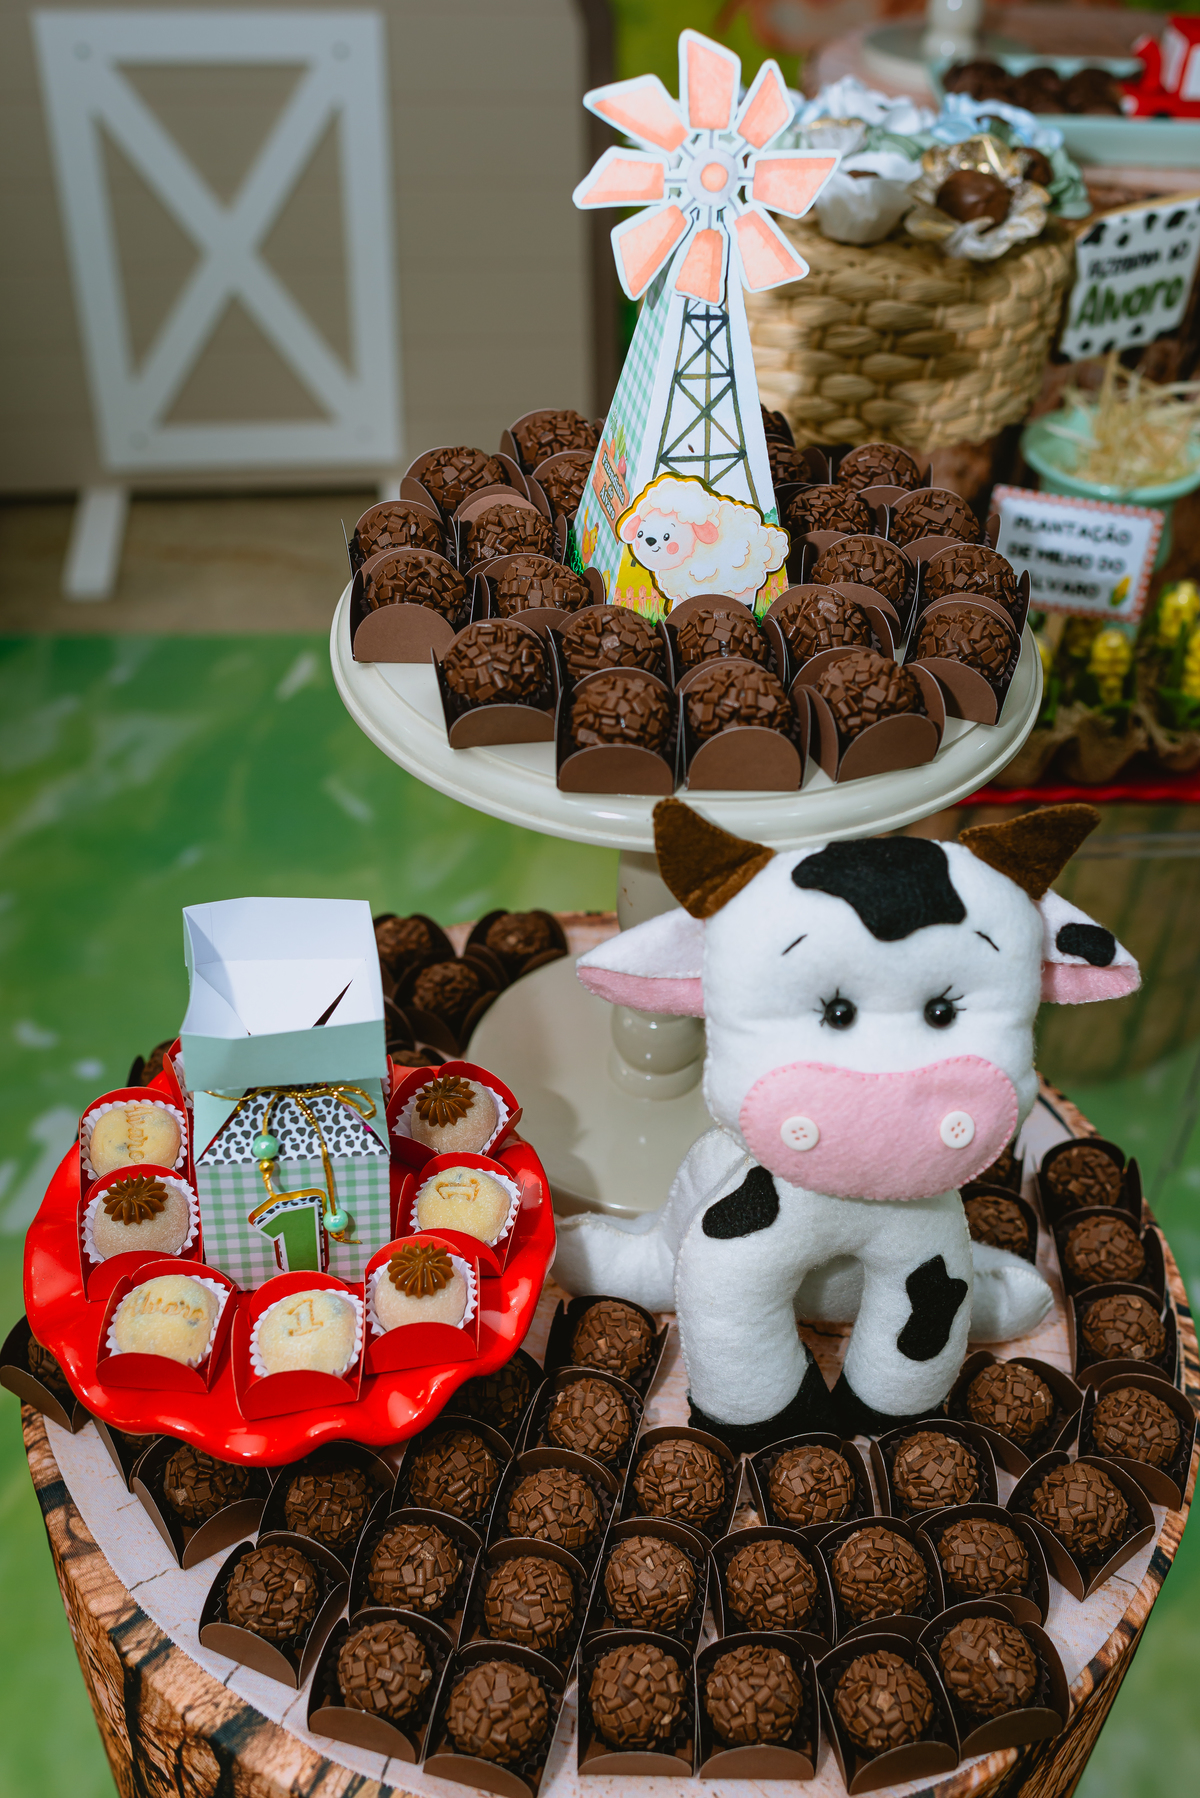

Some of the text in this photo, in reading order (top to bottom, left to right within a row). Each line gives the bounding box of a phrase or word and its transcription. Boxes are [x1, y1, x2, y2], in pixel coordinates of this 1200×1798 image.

[1013, 513, 1132, 547] PLANTAÇÃO
[254, 1199, 323, 1273] 1
[286, 1298, 324, 1337] 1
